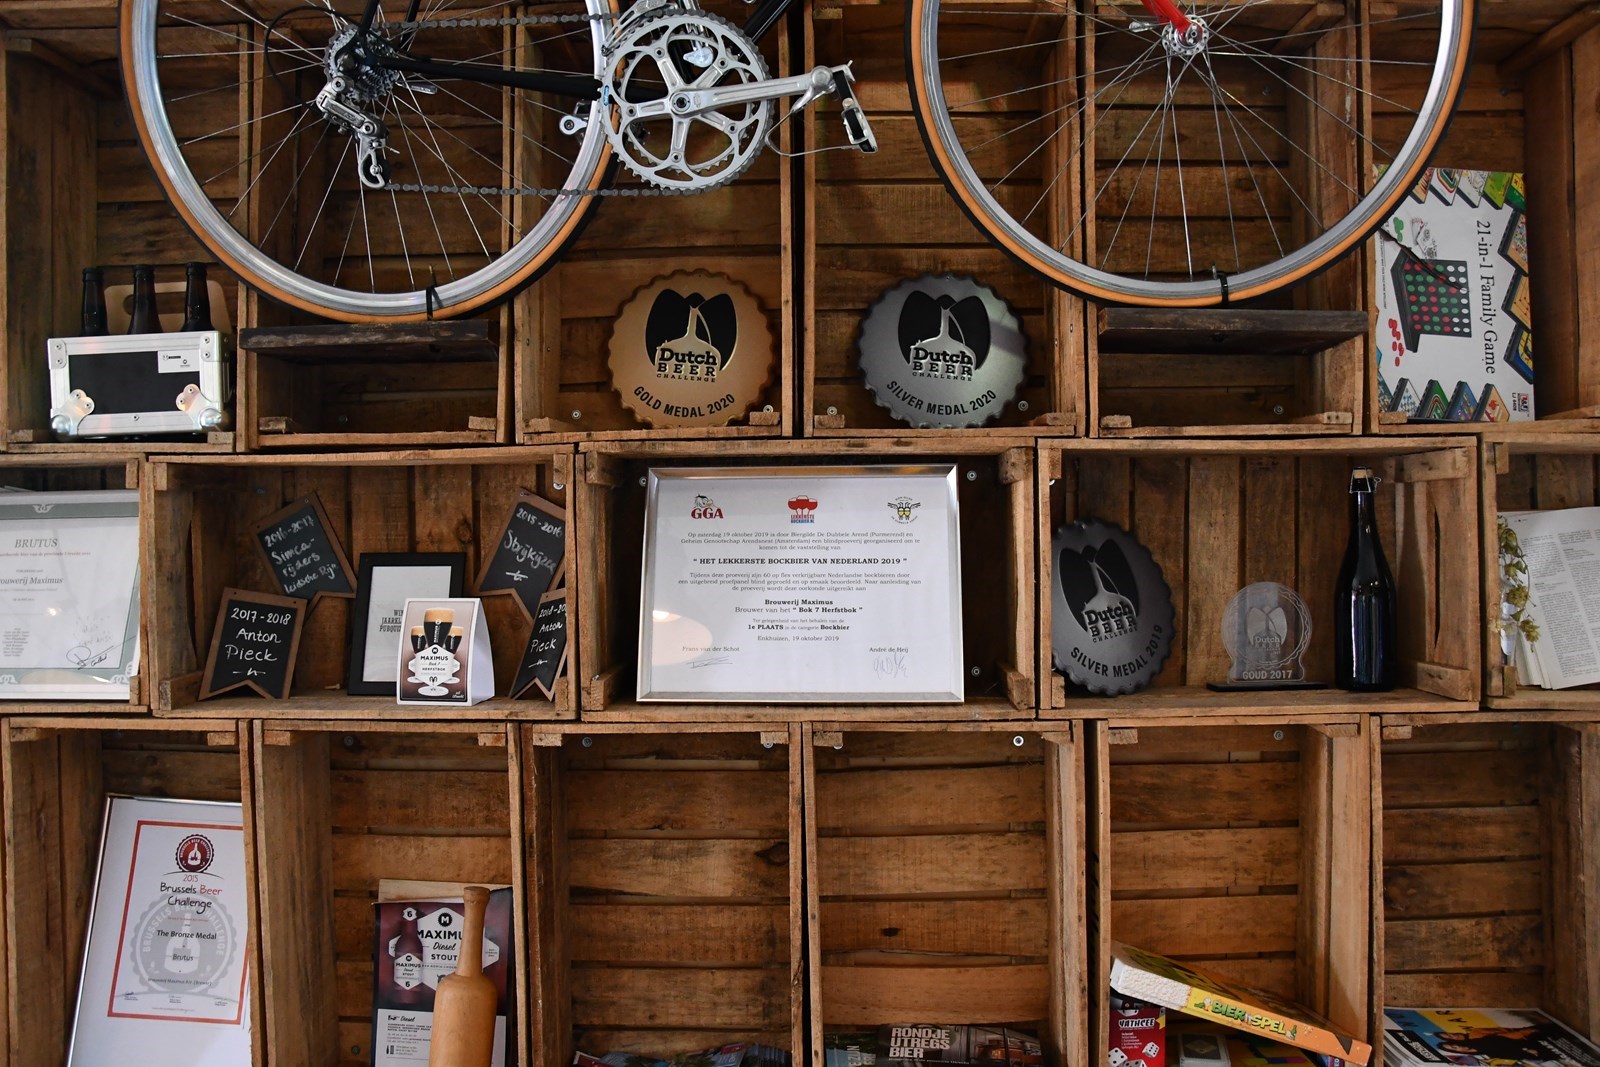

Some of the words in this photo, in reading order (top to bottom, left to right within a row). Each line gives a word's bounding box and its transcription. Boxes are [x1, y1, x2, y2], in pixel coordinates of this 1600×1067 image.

[1476, 220, 1491, 274] 21-in-1
[1480, 275, 1496, 325] Family
[659, 348, 718, 366] Dutch
[914, 347, 974, 365] Dutch
[1482, 330, 1498, 374] Game
[657, 362, 716, 376] BEER
[912, 361, 973, 376] BEER
[656, 374, 716, 383] CHALLENGE
[912, 372, 972, 382] CHALLENGE
[634, 386, 662, 410] GOLD
[664, 404, 705, 418] MEDAL
[707, 393, 735, 415] 2020
[887, 380, 923, 410] SILVER
[926, 404, 968, 416] MEDAL
[970, 390, 997, 411] 2020
[691, 508, 724, 519] GGA
[14, 538, 58, 548] BRUTUS
[1084, 601, 1134, 625] Dutch
[539, 622, 563, 633] Anton
[1090, 616, 1137, 637] BEER
[236, 628, 281, 643] Anton
[1092, 626, 1138, 643] CHALLENGE
[224, 644, 278, 661] Pieck
[530, 638, 557, 652] Pieck
[1070, 647, 1108, 677] SILVER
[1113, 655, 1148, 678] MEDAL
[1145, 624, 1162, 657] 2019
[1242, 671, 1267, 679] GOUD
[1270, 670, 1293, 679] 2017
[160, 882, 197, 894] Brussels
[200, 884, 223, 895] Beer
[168, 895, 212, 915] Challenge
[196, 932, 217, 940] Medal
[432, 942, 456, 951] Diesel
[1211, 1000, 1245, 1022] BIER
[1250, 1011, 1286, 1035] SPEL
[892, 1028, 950, 1040] RONDJE
[890, 1038, 950, 1050] UTREGS
[889, 1047, 924, 1058] BIER
